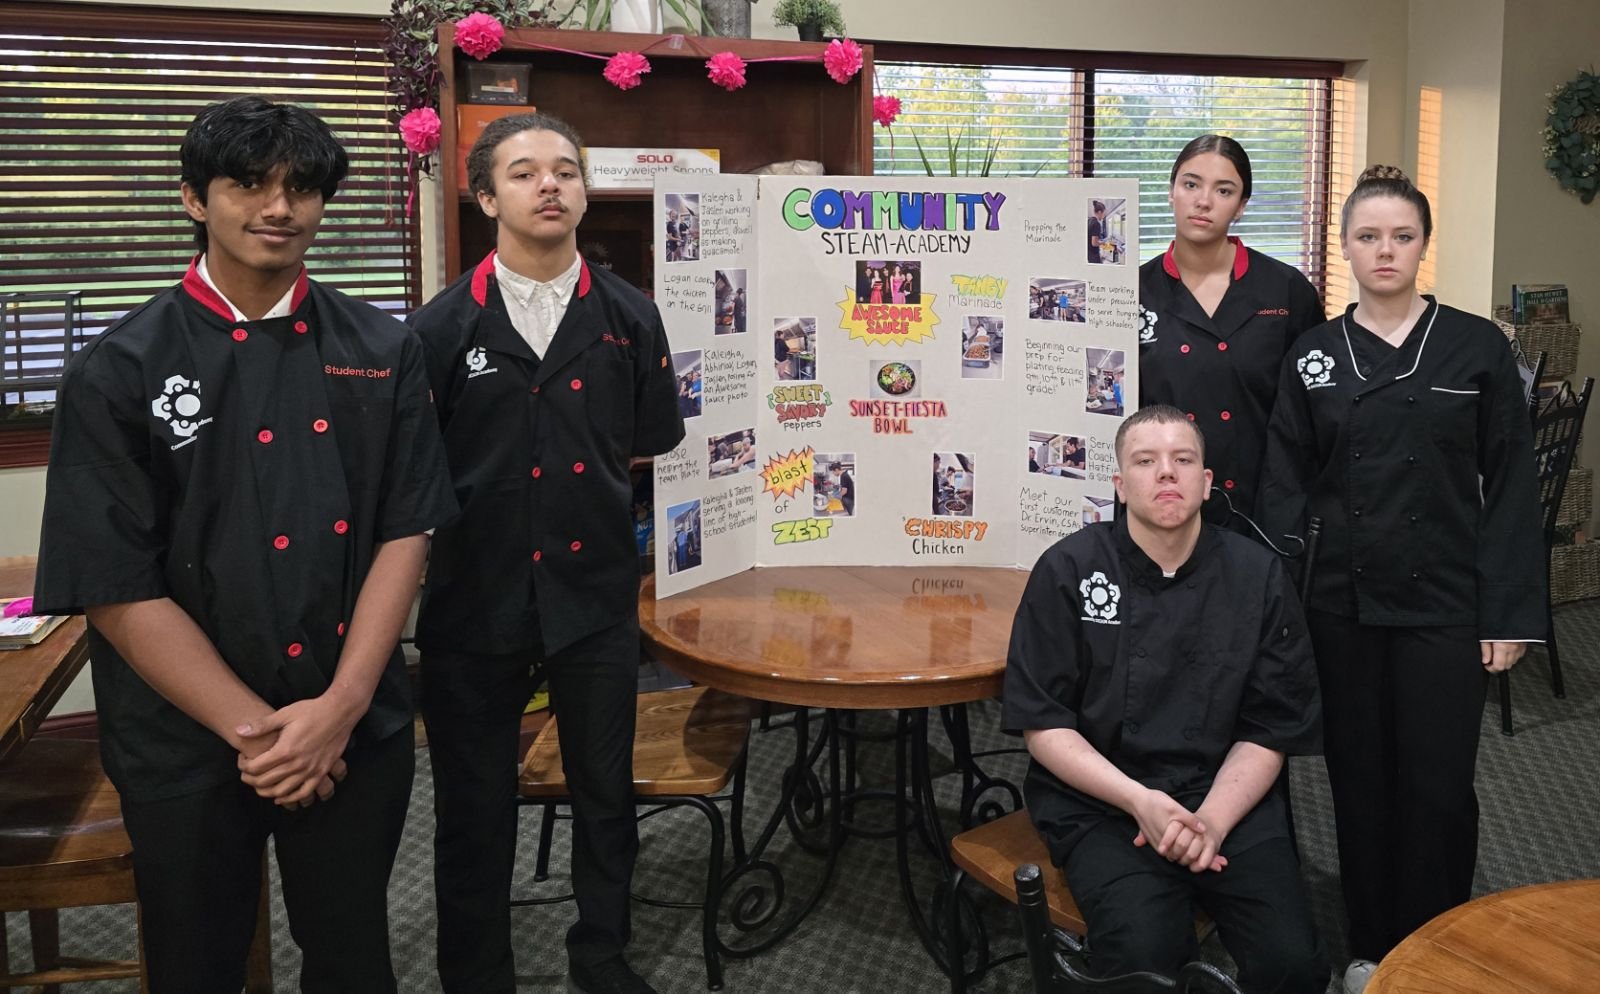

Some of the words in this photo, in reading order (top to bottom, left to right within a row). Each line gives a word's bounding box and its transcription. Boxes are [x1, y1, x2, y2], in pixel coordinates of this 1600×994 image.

[637, 154, 673, 164] SOLO
[593, 165, 668, 176] Heavyweight
[725, 206, 751, 217] working
[782, 187, 1007, 231] COMMUNITY
[701, 218, 711, 226] on
[713, 217, 738, 229] grilling
[1024, 220, 1053, 234] Prepping
[711, 238, 737, 248] making
[821, 231, 971, 255] STEAM-ACADEMY
[1026, 234, 1062, 243] Marinade
[664, 274, 691, 284] Logan
[950, 274, 1009, 298] TANGY
[1088, 281, 1106, 293] Team
[1108, 286, 1135, 299] working
[1087, 296, 1107, 304] under
[1110, 297, 1137, 306] pressure
[852, 303, 922, 323] AWESOME
[866, 319, 910, 335] SAUCE
[1025, 338, 1065, 355] Beginning
[1025, 352, 1044, 361] prep
[324, 365, 366, 377] Student
[366, 368, 392, 378] Chef
[727, 392, 749, 404] photo
[773, 384, 823, 404] SWEET
[850, 400, 948, 418] SUNSET-FIESTA
[874, 418, 914, 434] BOWL
[1090, 436, 1114, 449] Servi
[1088, 449, 1115, 463] Coach
[685, 459, 698, 471] the
[1089, 461, 1120, 473] Hatfie
[770, 460, 809, 485] blast
[1019, 486, 1048, 502] Meet
[1054, 496, 1073, 506] our
[774, 499, 790, 514] of
[1043, 506, 1080, 518] customer
[772, 517, 833, 545] ZEST
[904, 517, 988, 541] CHRISPY
[912, 538, 964, 555] Chicken
